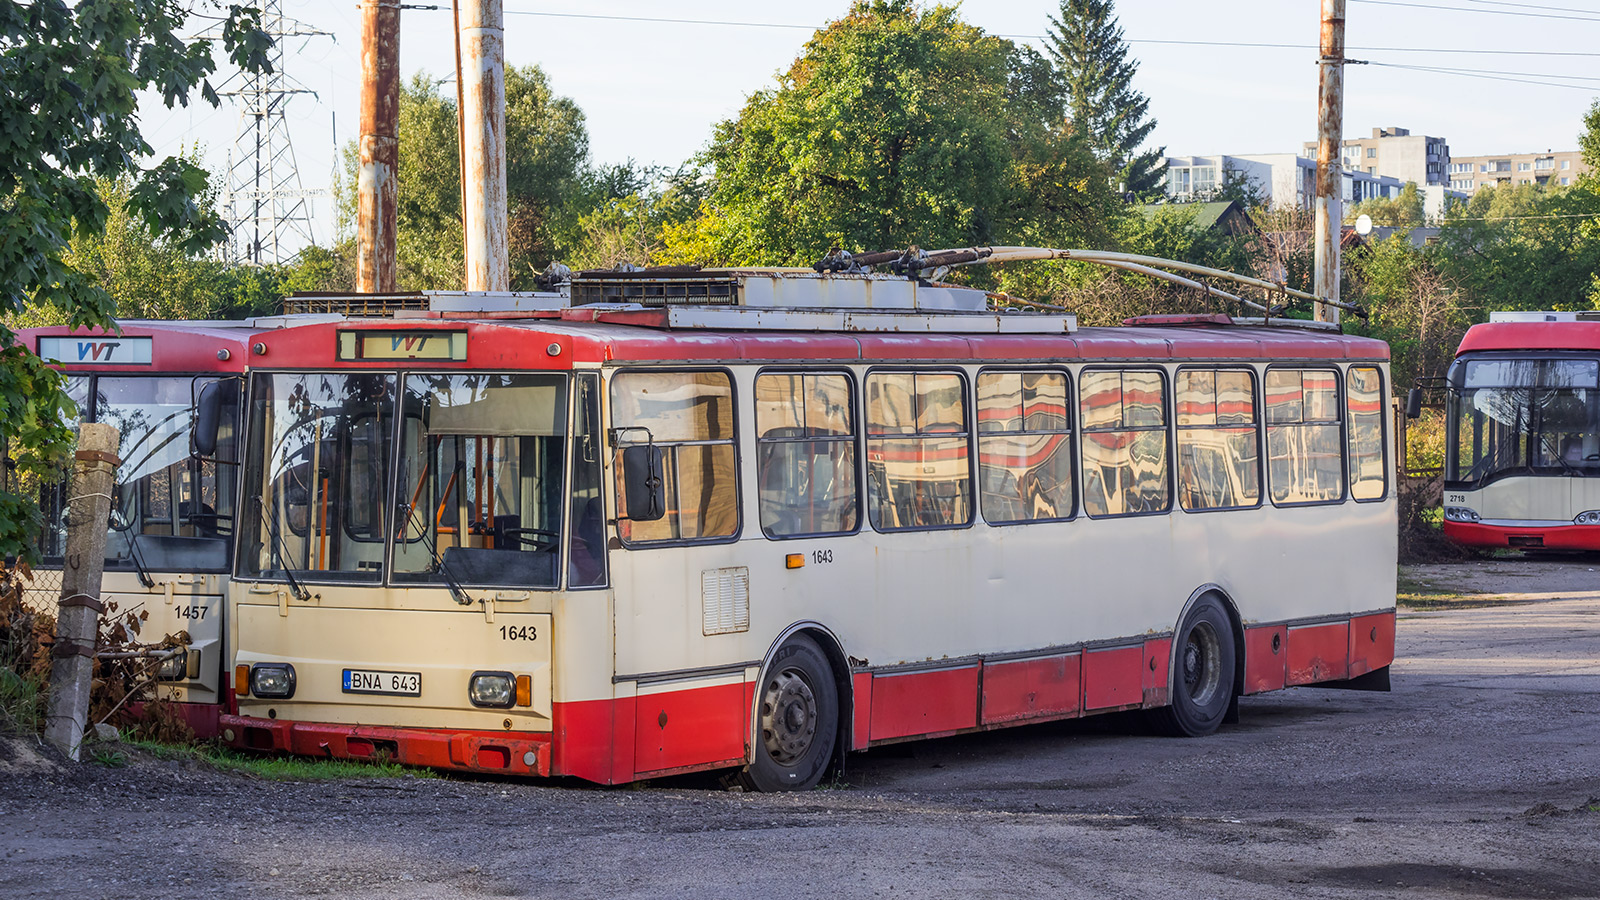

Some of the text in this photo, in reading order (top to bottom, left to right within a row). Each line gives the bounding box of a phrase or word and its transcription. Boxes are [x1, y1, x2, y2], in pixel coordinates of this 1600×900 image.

[391, 334, 433, 351] VVT
[78, 342, 120, 361] VVT
[812, 549, 833, 564] 1643
[175, 605, 208, 619] 1457
[500, 625, 537, 641] 1643
[353, 673, 382, 689] BNA
[392, 675, 417, 691] 643
